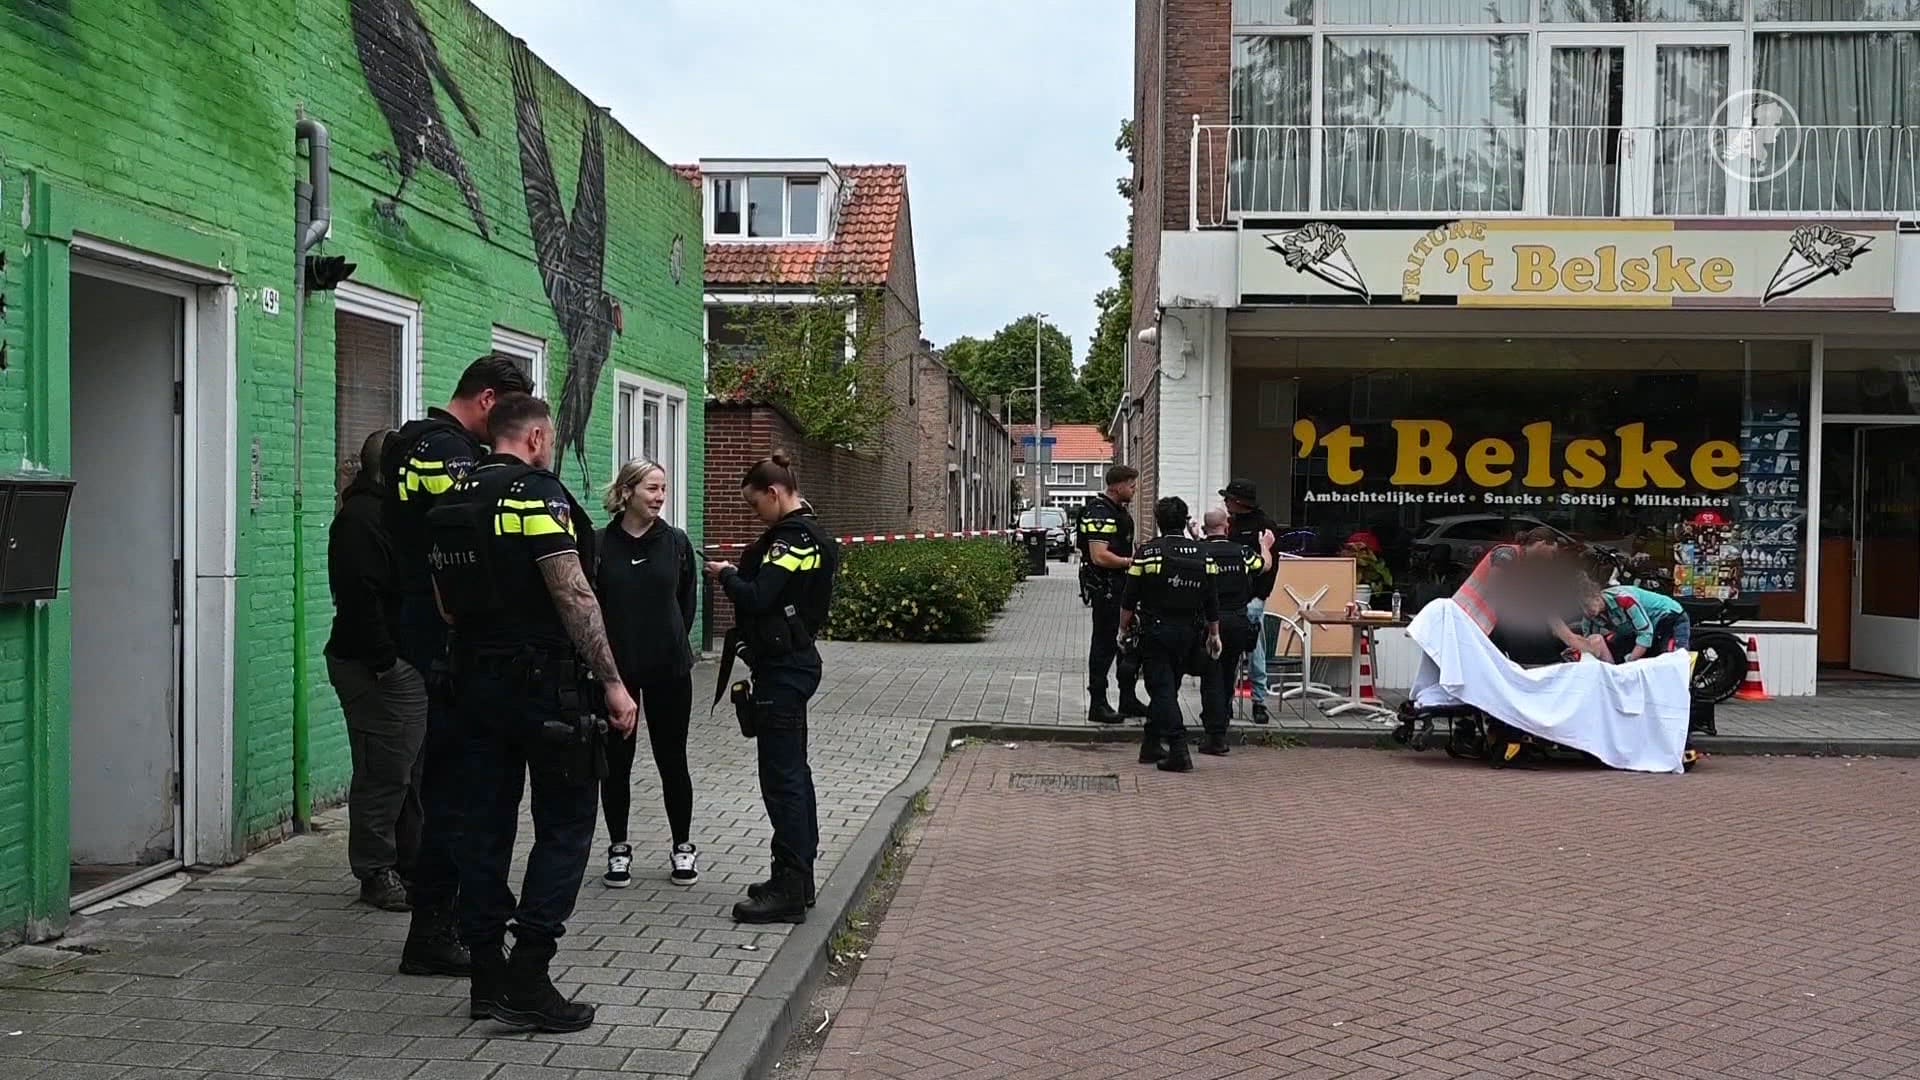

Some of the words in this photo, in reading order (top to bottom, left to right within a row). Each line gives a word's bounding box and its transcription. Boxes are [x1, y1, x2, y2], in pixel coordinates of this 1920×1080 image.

[1401, 221, 1488, 303] FRITURE
[1512, 244, 1734, 292] Belske
[1389, 419, 1742, 490] Belske
[1303, 490, 1425, 505] Ambachtelijke
[1427, 492, 1466, 504] friet
[1483, 492, 1543, 505] Snacks
[1559, 493, 1616, 508] Softijs
[1634, 494, 1730, 507] Milkshakes
